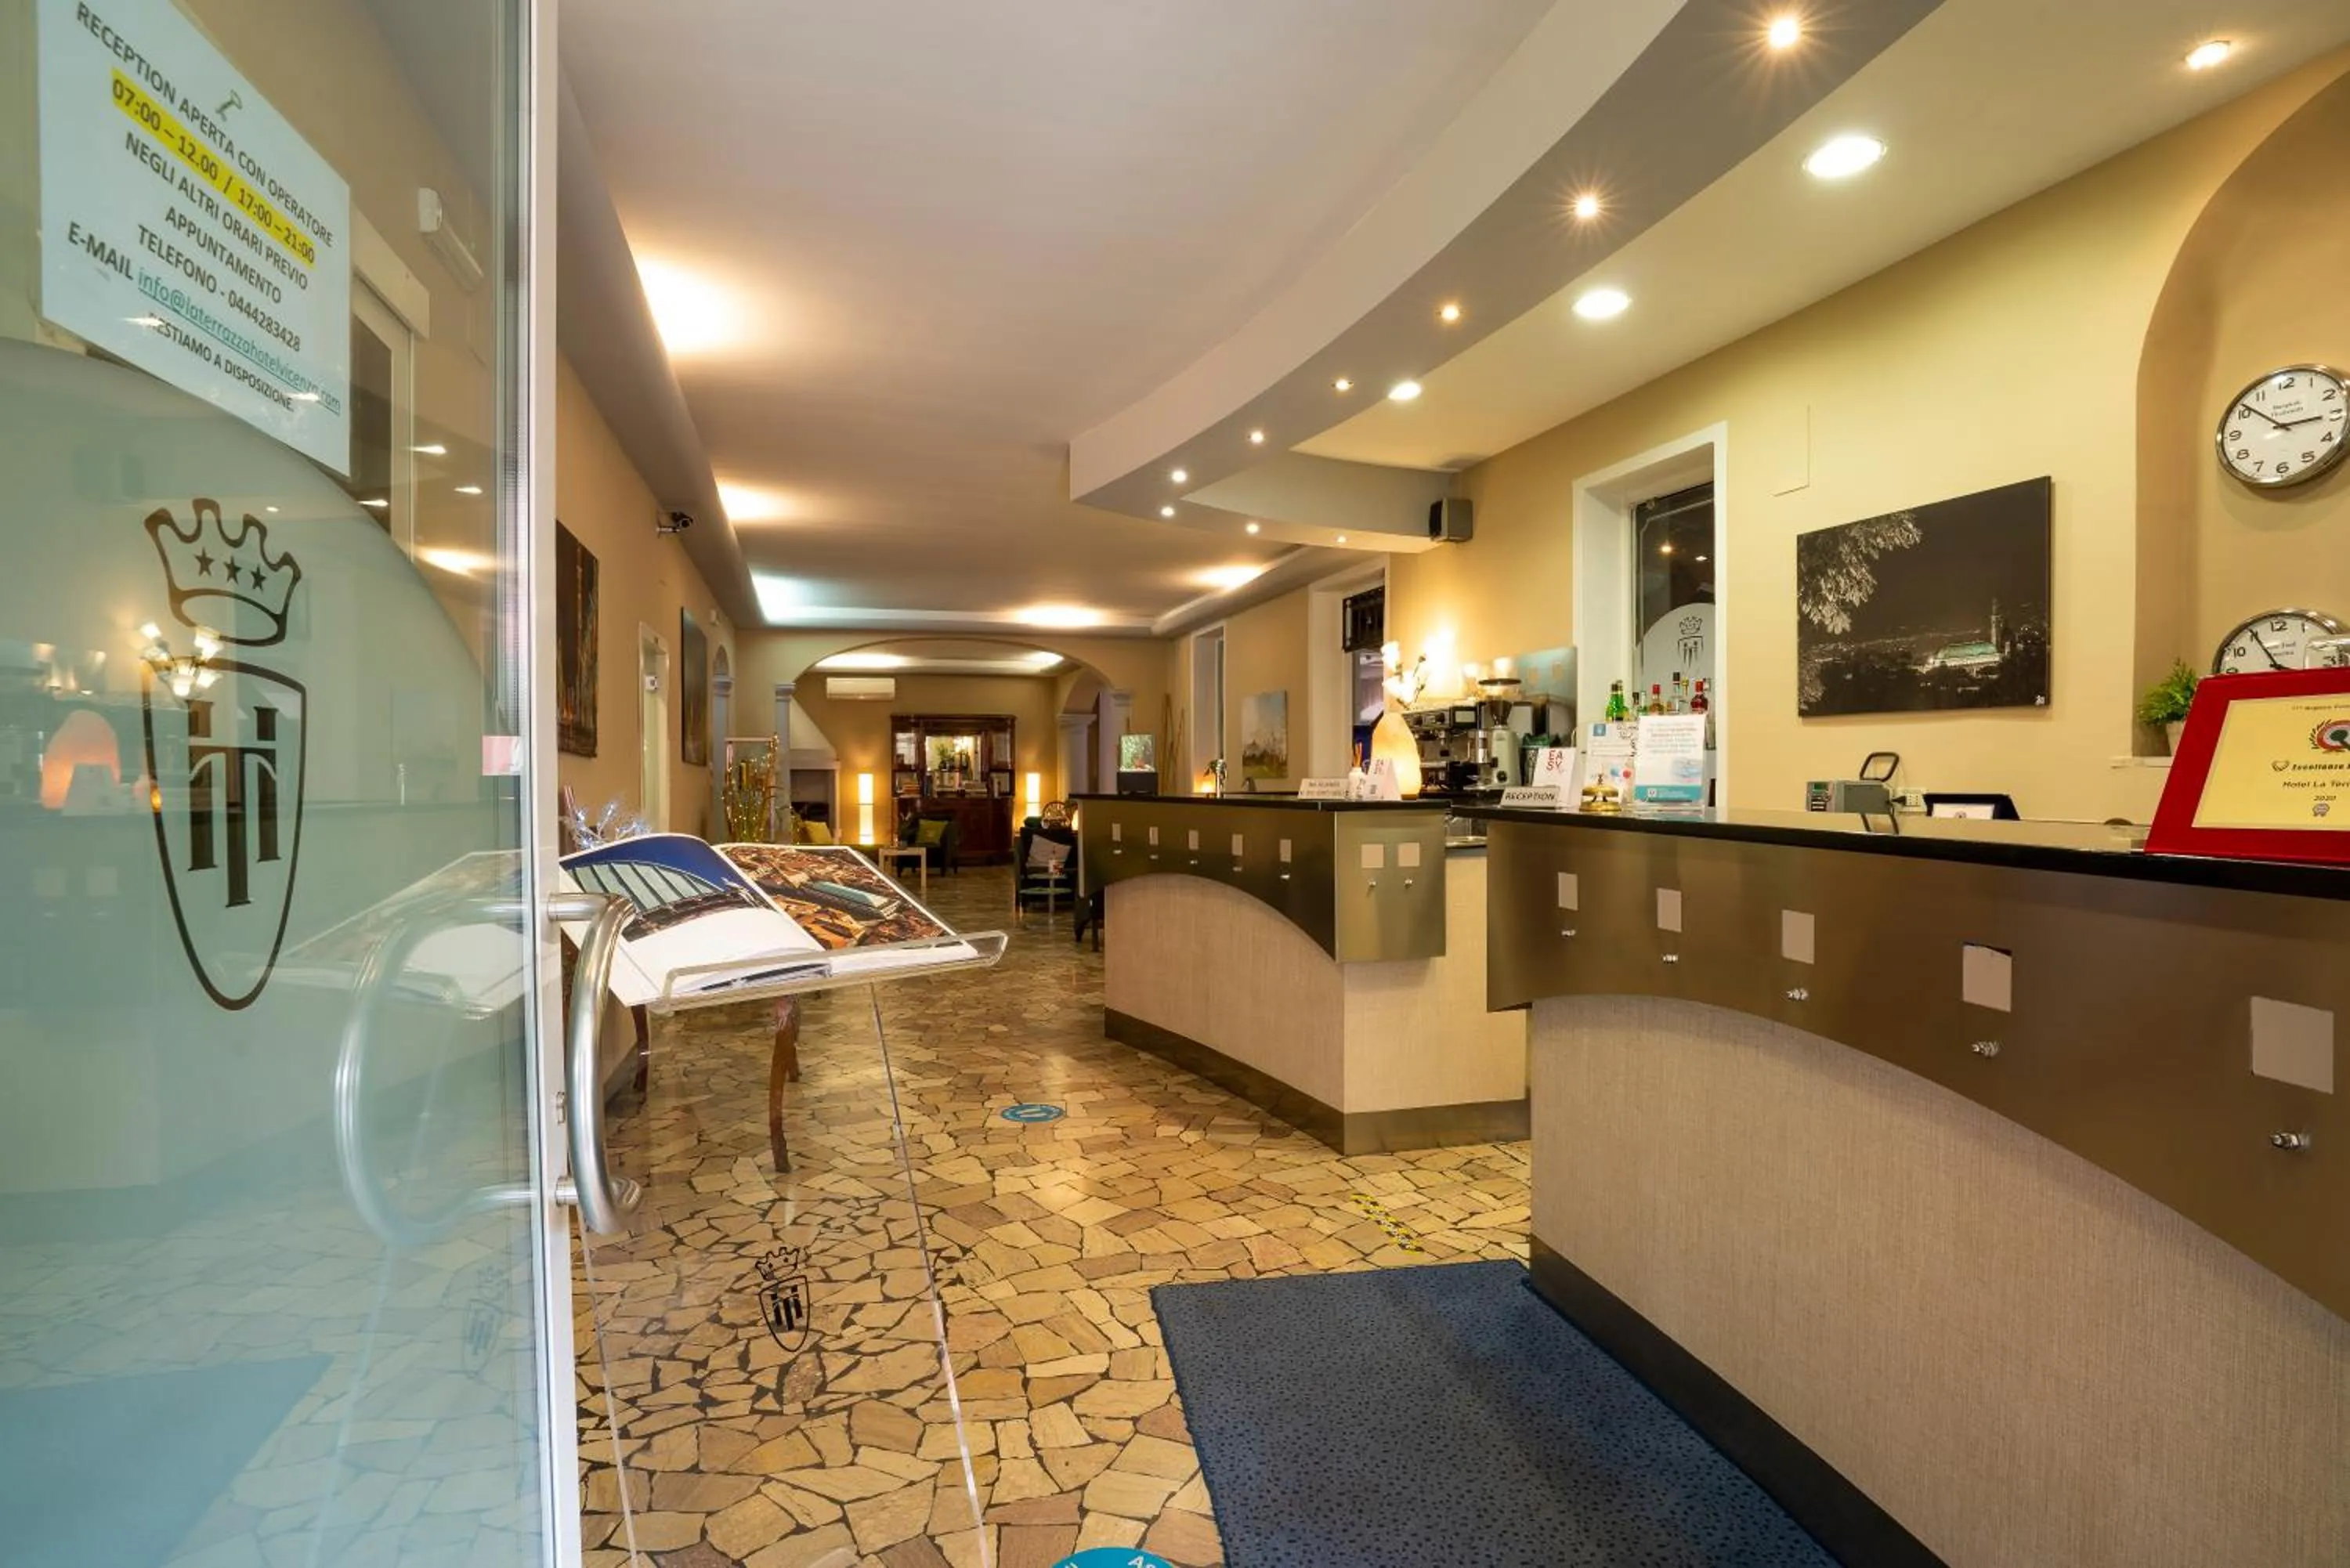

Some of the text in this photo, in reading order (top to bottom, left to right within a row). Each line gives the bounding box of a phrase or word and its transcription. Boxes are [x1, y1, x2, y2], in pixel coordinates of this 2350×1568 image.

[78, 2, 333, 248] RECEPTION APERTA CON OPERATORE
[112, 78, 161, 132] 07:00
[178, 135, 219, 180] 12.00
[237, 188, 272, 228] 17:00
[284, 226, 315, 264] 21:00
[125, 132, 308, 290] NEGLI ALTRI ORARI PREVIO
[164, 205, 281, 304] APPUNTAMENTO
[137, 223, 217, 294] TELEFONO
[228, 290, 302, 352] 0444283428
[68, 221, 341, 417] E-MAIL info@laterrazzahotelvicenzacom
[148, 312, 212, 362] ESTIAMO
[213, 353, 222, 370] A
[2278, 377, 2295, 390] 12
[2310, 377, 2313, 388] 1
[2255, 390, 2266, 402] 11
[2322, 388, 2337, 402] 2
[2238, 408, 2252, 420] 10
[2229, 430, 2242, 441] 9
[2320, 432, 2334, 443] 4
[2236, 449, 2250, 460] 8
[2301, 451, 2315, 463] 5
[2253, 461, 2265, 472] 7
[2276, 462, 2290, 474] 6
[2271, 621, 2288, 632] 12
[2233, 647, 2246, 658] 10
[1505, 792, 1556, 801] RECEPTION
